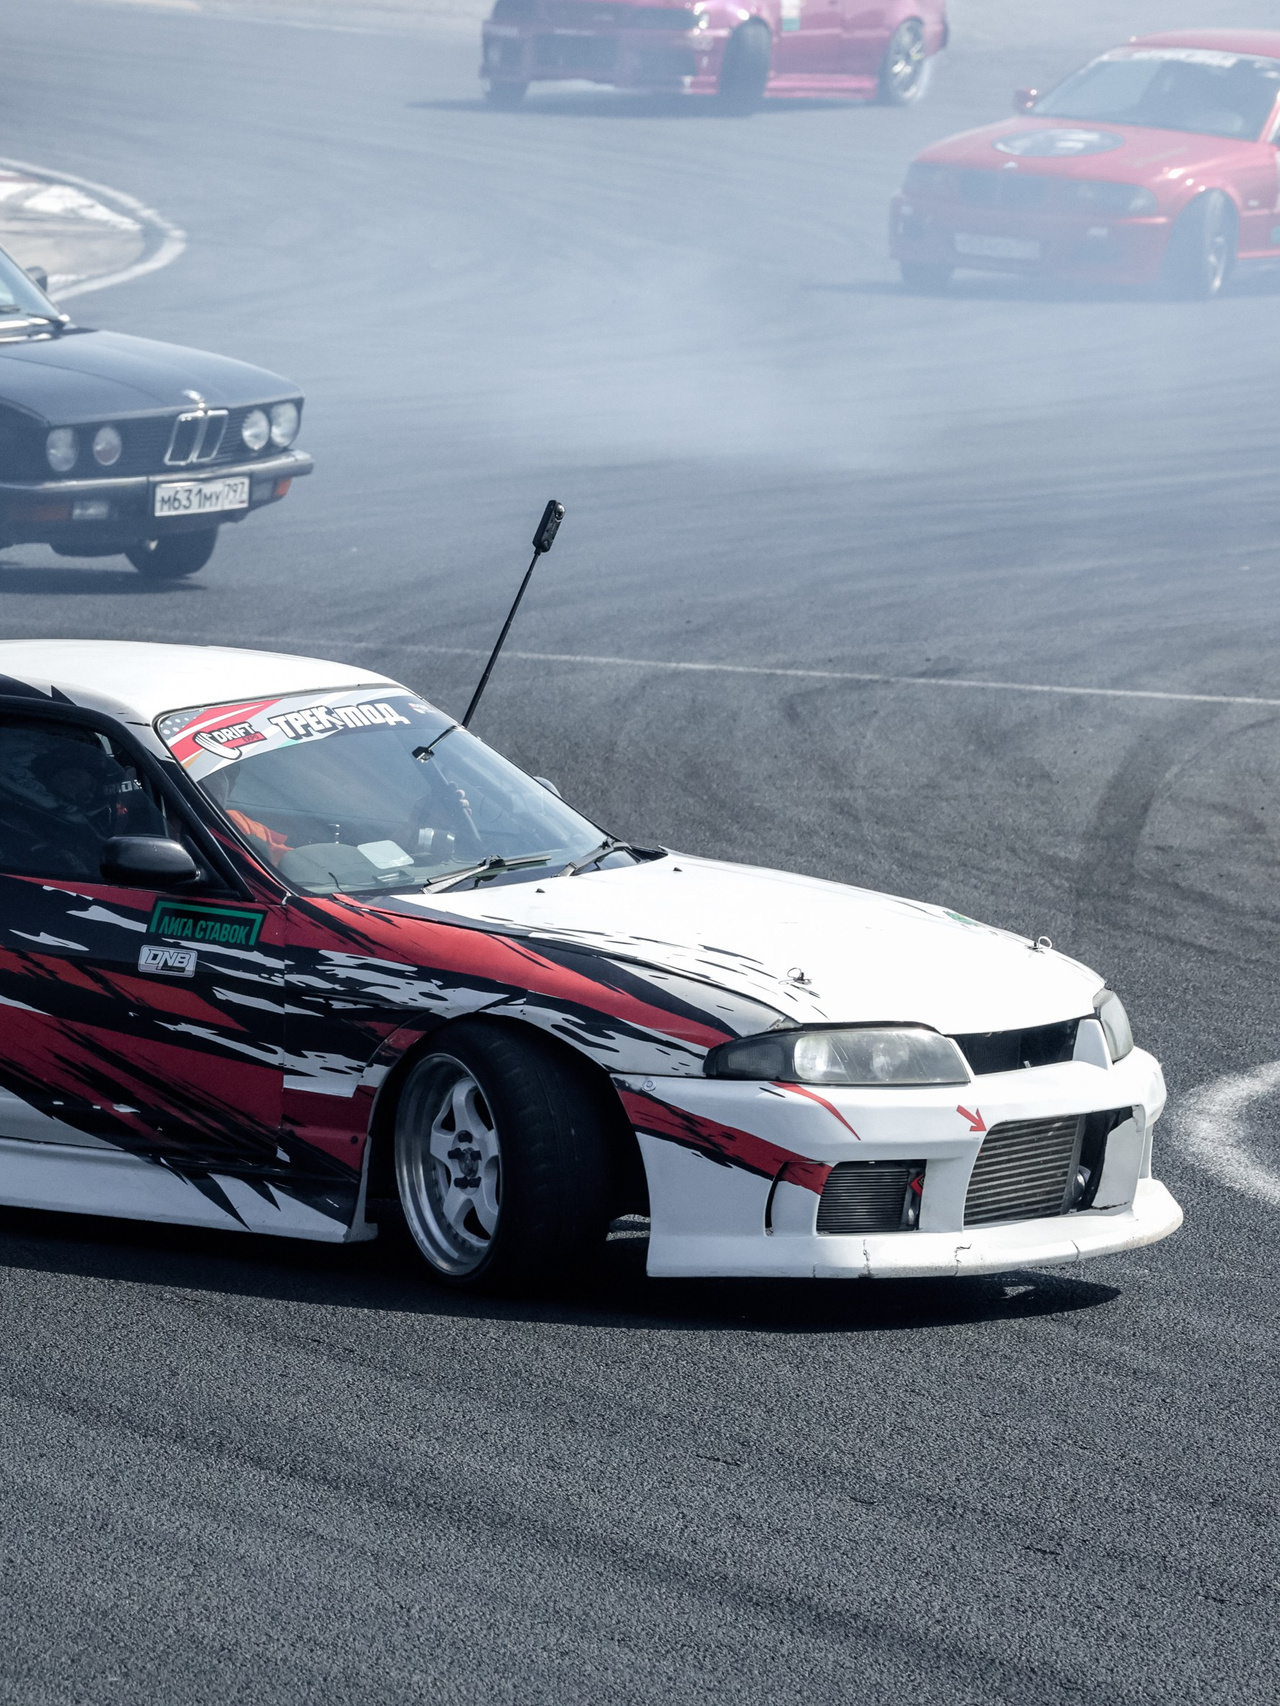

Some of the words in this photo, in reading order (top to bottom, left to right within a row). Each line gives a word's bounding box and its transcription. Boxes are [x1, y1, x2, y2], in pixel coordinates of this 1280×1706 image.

[224, 482, 246, 500] 797
[211, 721, 256, 743] DRIFT
[242, 734, 260, 743] EXPO
[158, 915, 193, 938] ЛИГА
[195, 920, 250, 945] СТАВОК
[145, 949, 191, 970] DNB
